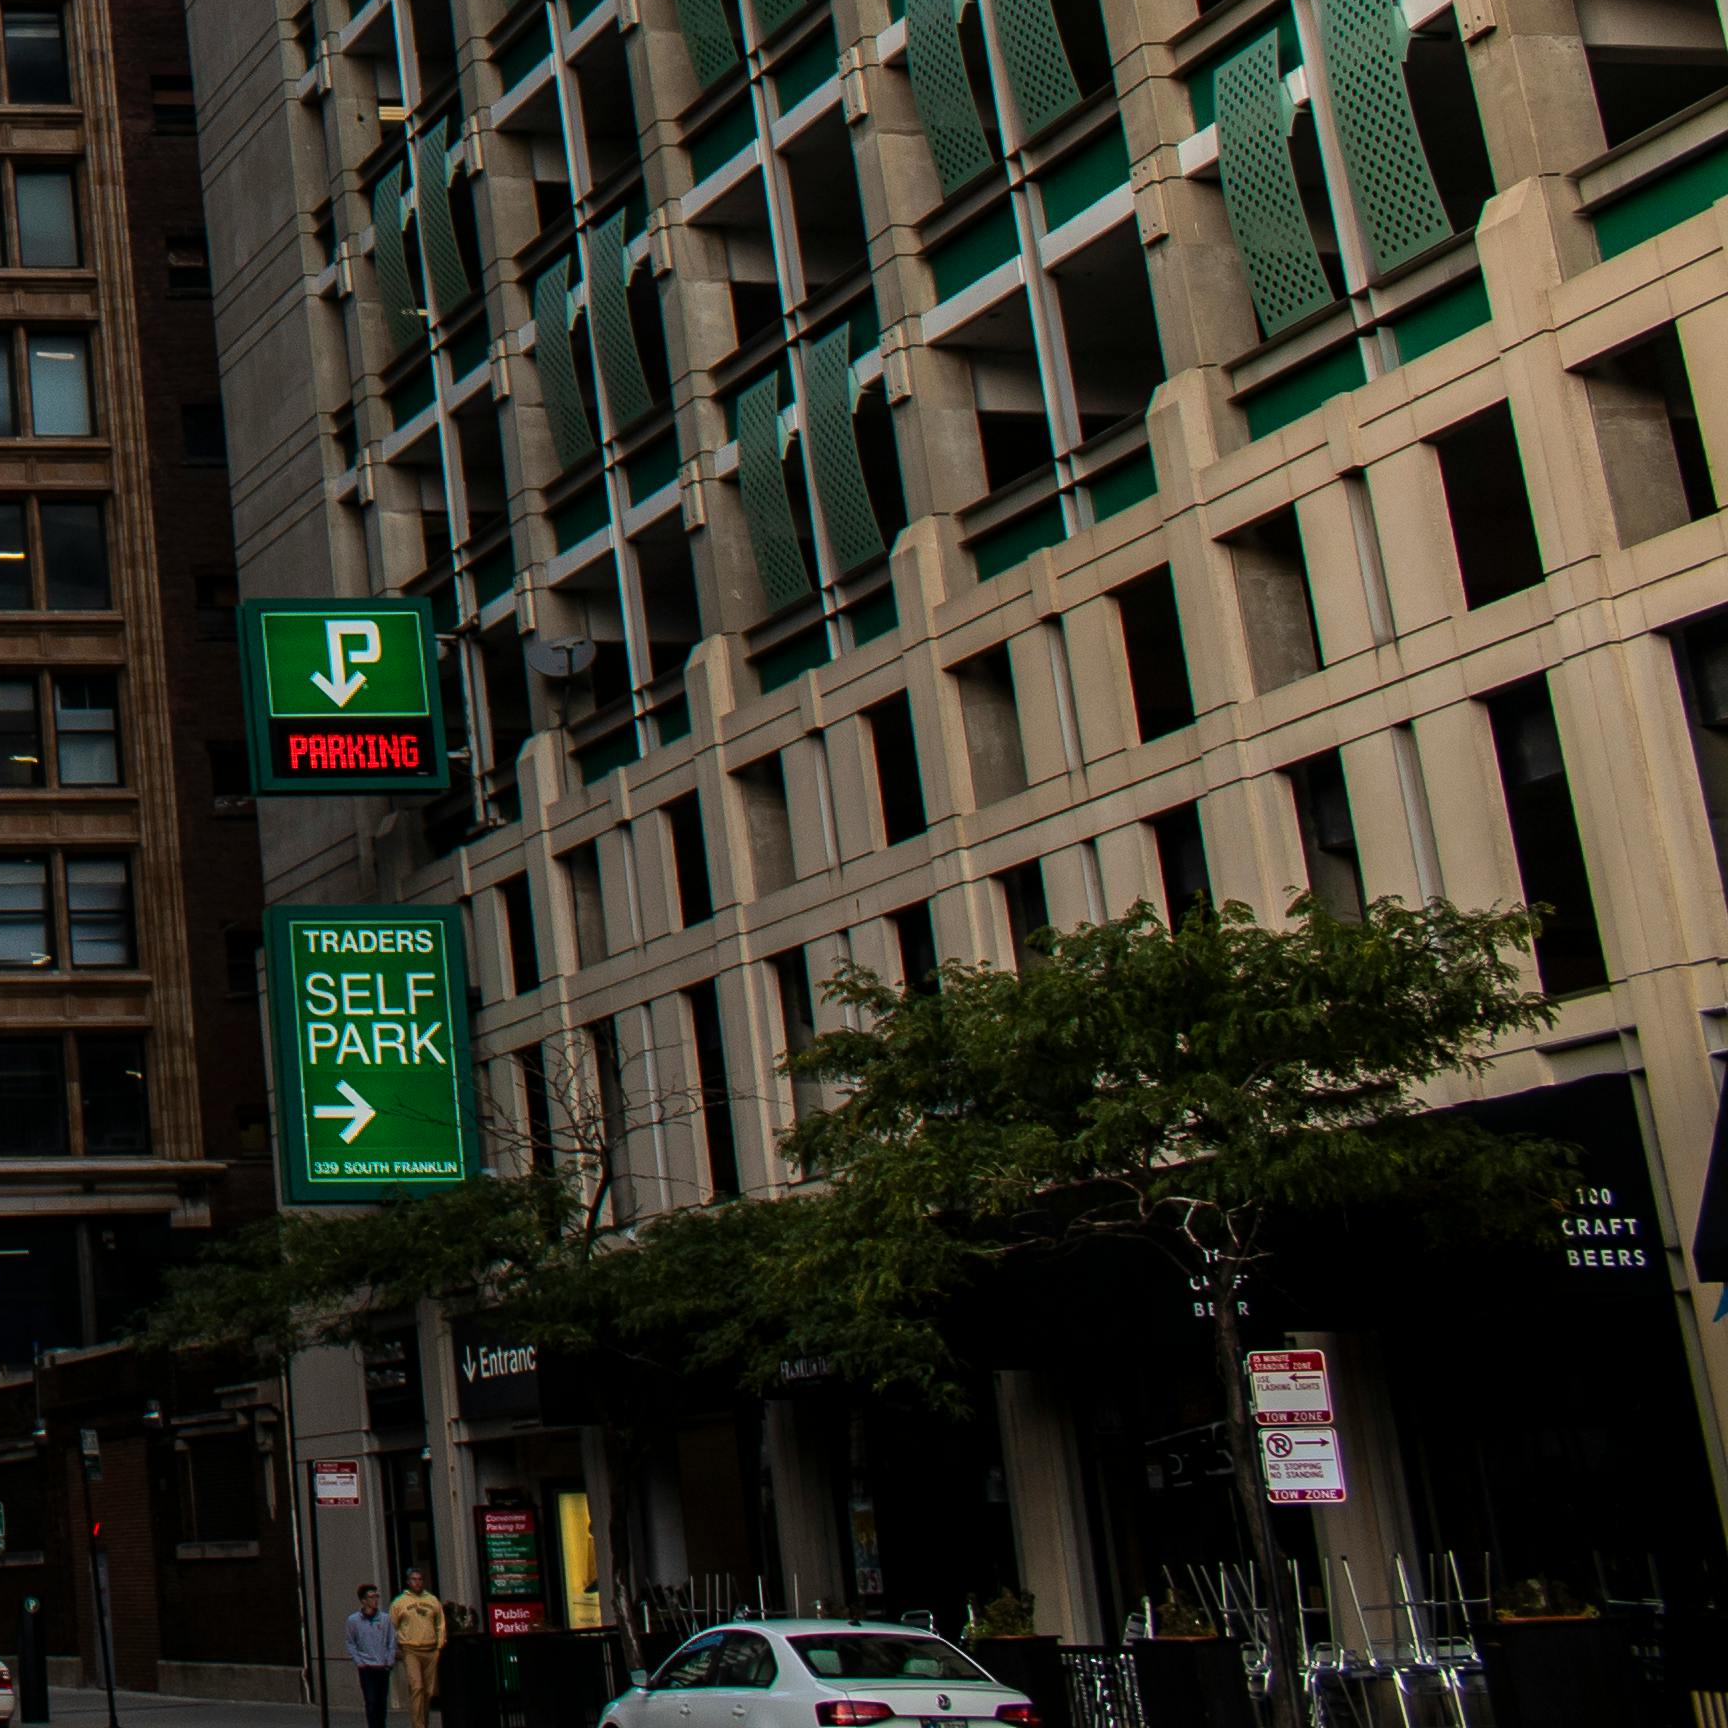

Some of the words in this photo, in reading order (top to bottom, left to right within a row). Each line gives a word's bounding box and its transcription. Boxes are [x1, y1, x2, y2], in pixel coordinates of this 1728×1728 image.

[289, 734, 421, 770] PARKING
[303, 929, 434, 954] TRADERS
[305, 972, 436, 1017] SELF
[307, 1021, 446, 1065] PARK
[343, 1161, 389, 1175] SOUTH
[393, 1161, 458, 1174] FRANKLIN
[1561, 1218, 1638, 1235] CRAFT
[1566, 1249, 1647, 1266] BEERS
[1254, 1362, 1290, 1371] STANDING
[1293, 1361, 1313, 1370] ZONE
[1256, 1375, 1271, 1383] USE
[1257, 1383, 1292, 1391] FLASHING
[1295, 1382, 1321, 1390] LIGHTS
[1264, 1413, 1288, 1423] TOW
[1293, 1412, 1324, 1422] ZONE
[1284, 1463, 1323, 1471] STOPPING
[1286, 1471, 1325, 1479] STANDING
[1274, 1490, 1299, 1500] TOW
[1305, 1489, 1339, 1499] ZONE
[494, 1608, 531, 1620] Public
